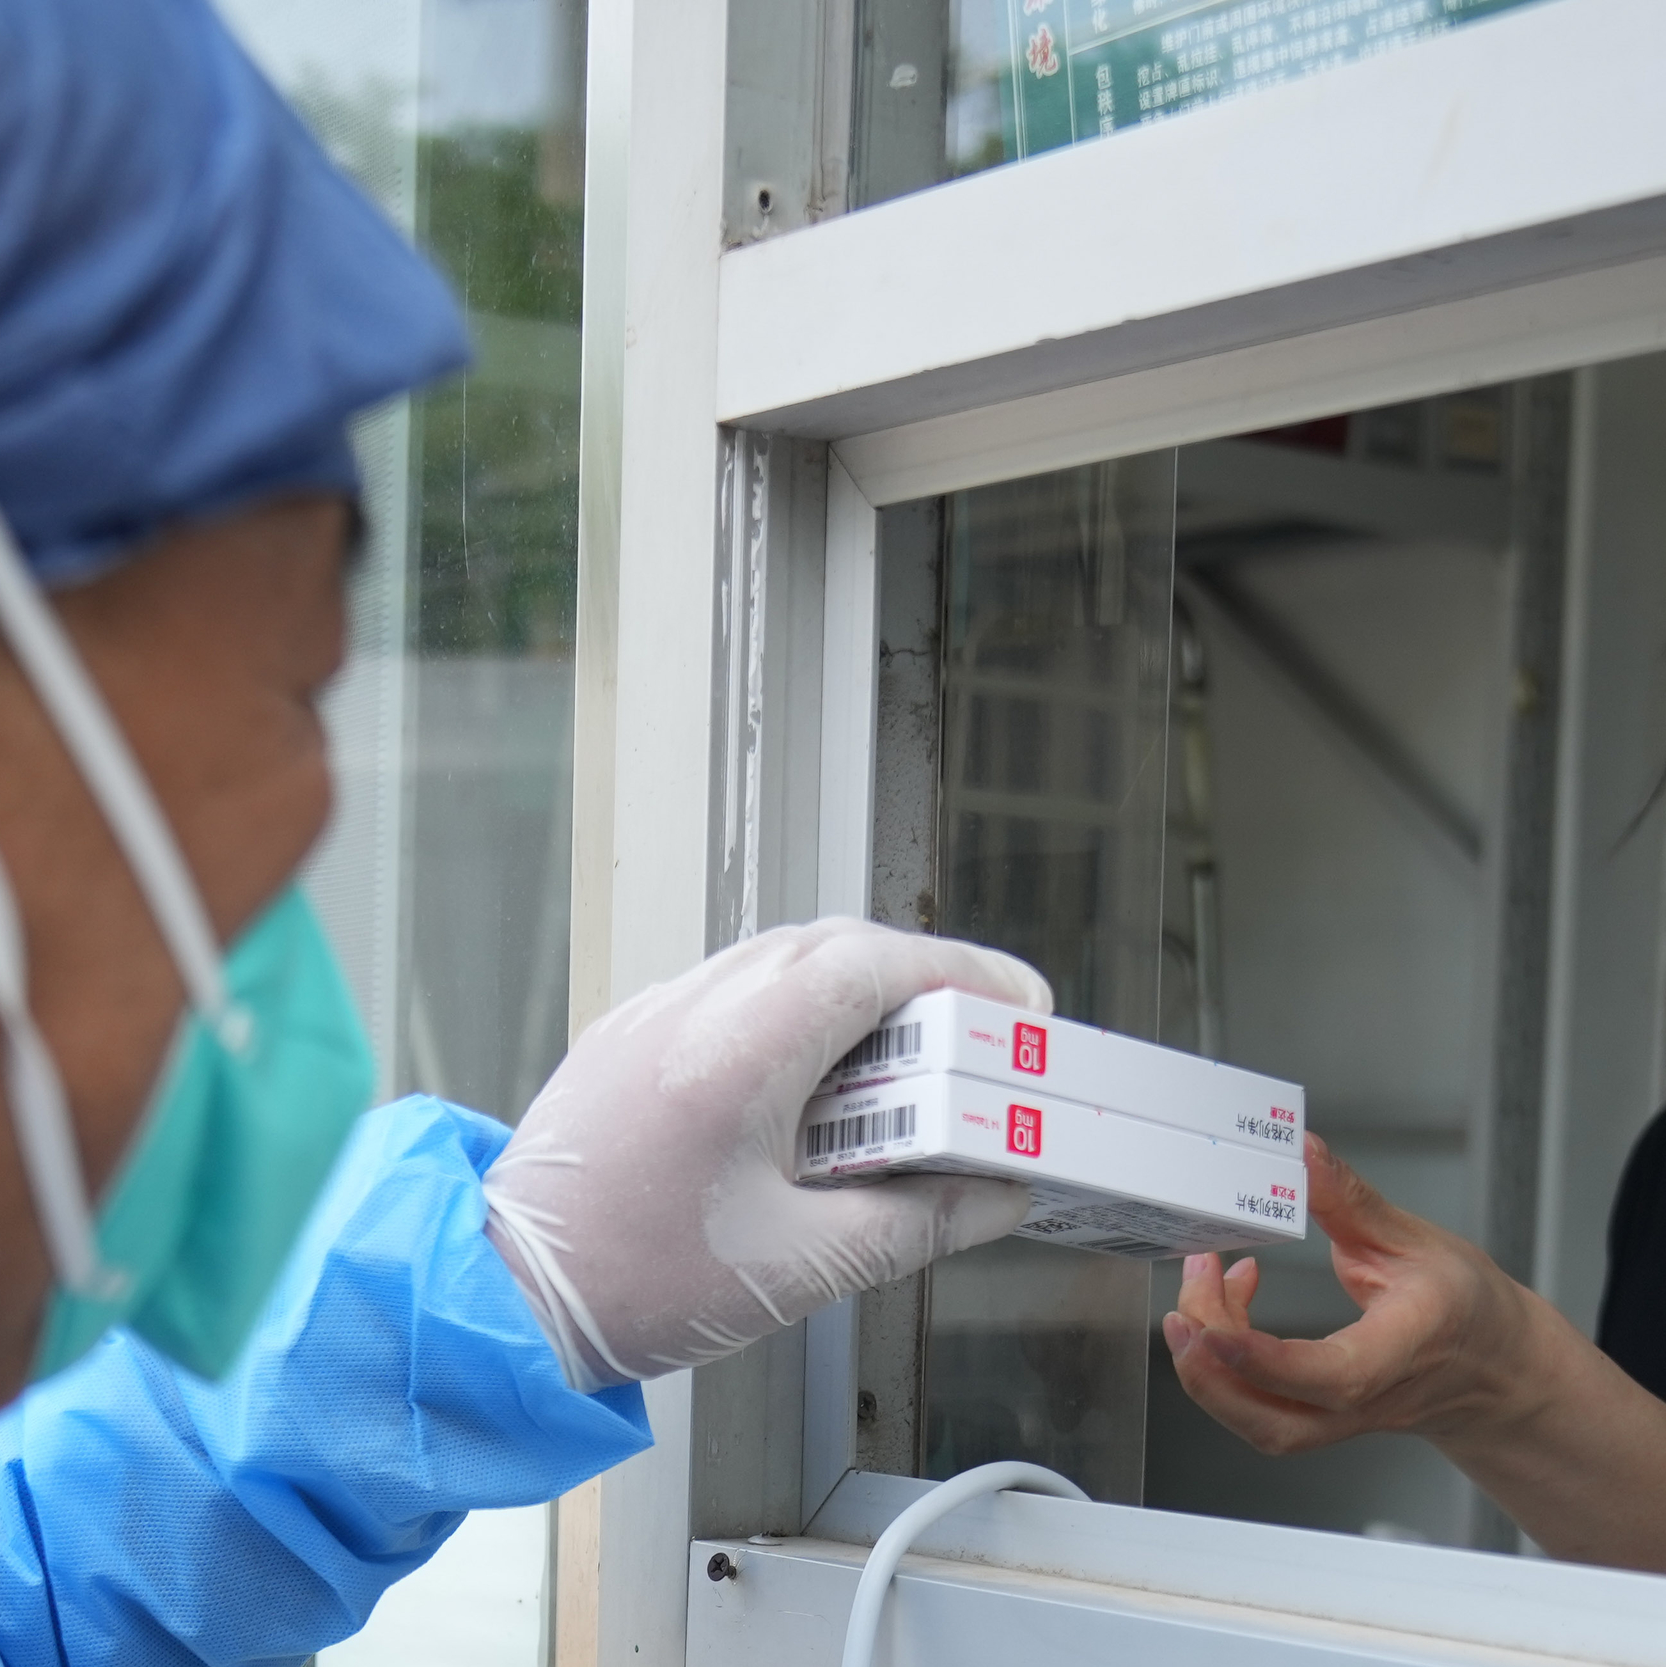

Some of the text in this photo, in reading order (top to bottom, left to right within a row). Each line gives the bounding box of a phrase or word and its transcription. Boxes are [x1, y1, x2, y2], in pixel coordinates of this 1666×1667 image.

[968, 1030, 996, 1047] Tablets
[1020, 1027, 1040, 1045] mg
[1019, 1045, 1041, 1071] 10
[962, 1112, 990, 1129] Tablets
[1015, 1109, 1034, 1127] mg
[1236, 1113, 1295, 1145] 达格列净片
[1013, 1127, 1036, 1153] 10
[1235, 1192, 1296, 1223] 达格列净片
